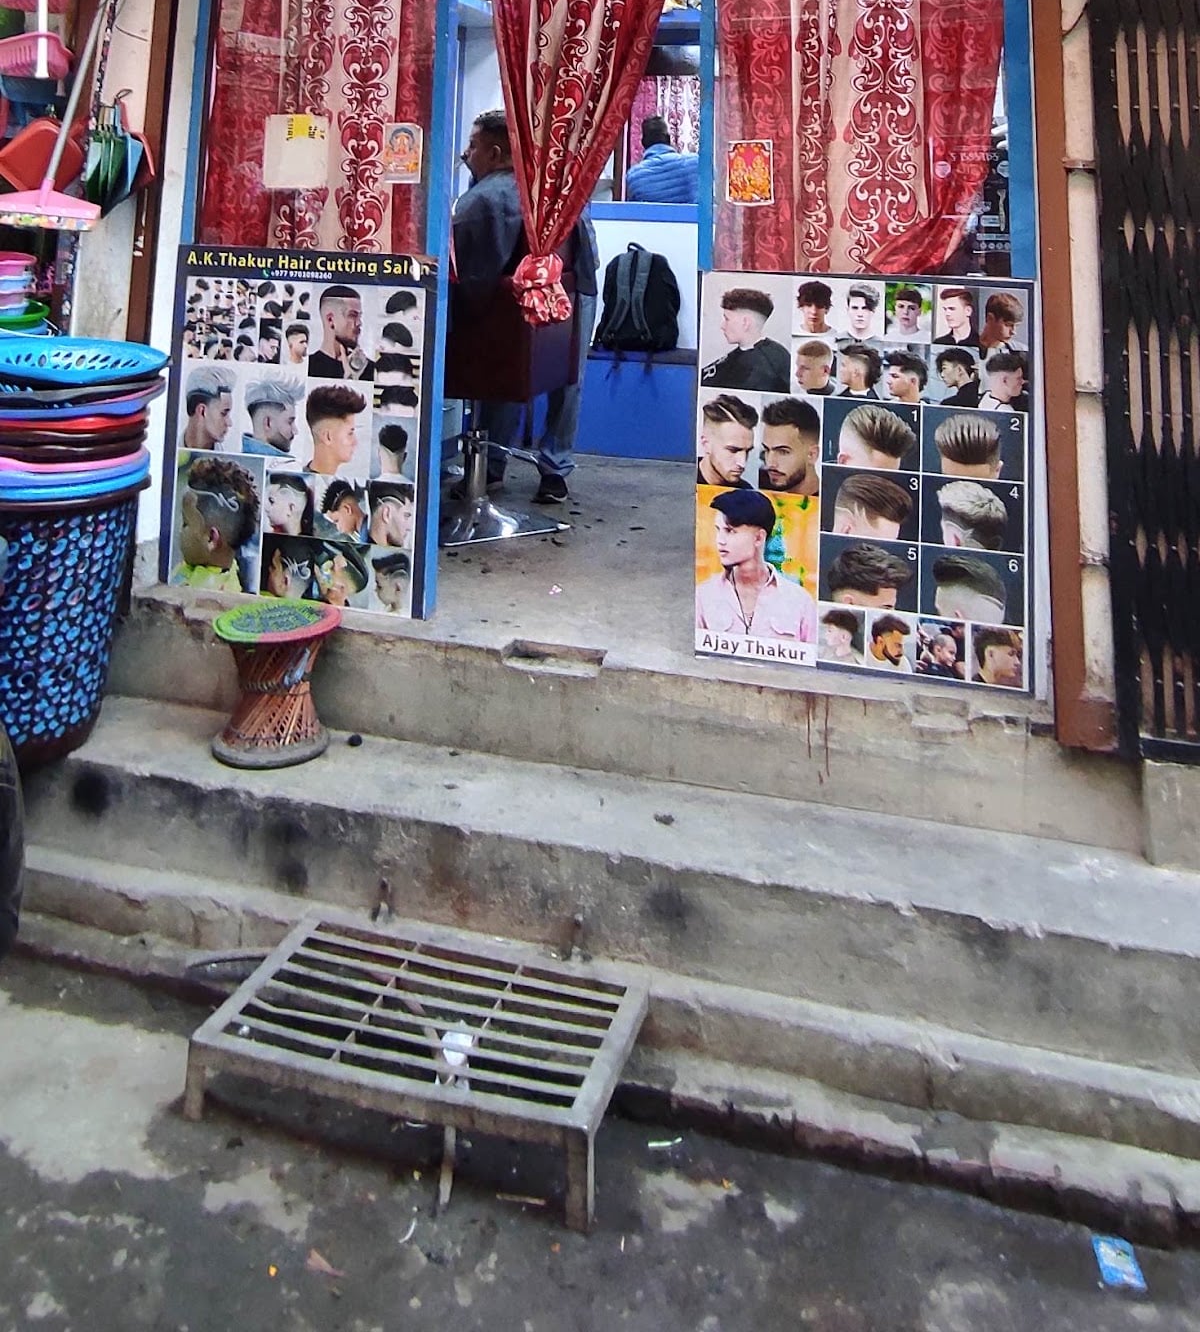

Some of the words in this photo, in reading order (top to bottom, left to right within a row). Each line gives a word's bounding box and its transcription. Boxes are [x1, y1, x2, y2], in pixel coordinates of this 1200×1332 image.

[187, 250, 274, 268] A.K.Thakur
[278, 255, 312, 270] Hair
[316, 256, 378, 276] Cutting
[911, 410, 918, 422] 1
[1010, 418, 1020, 431] 2
[909, 477, 919, 491] 3
[1009, 486, 1019, 500] 4
[907, 547, 917, 561] 5
[1008, 558, 1019, 573] 6
[702, 634, 740, 654] Ajay
[745, 639, 807, 661] Thakur
